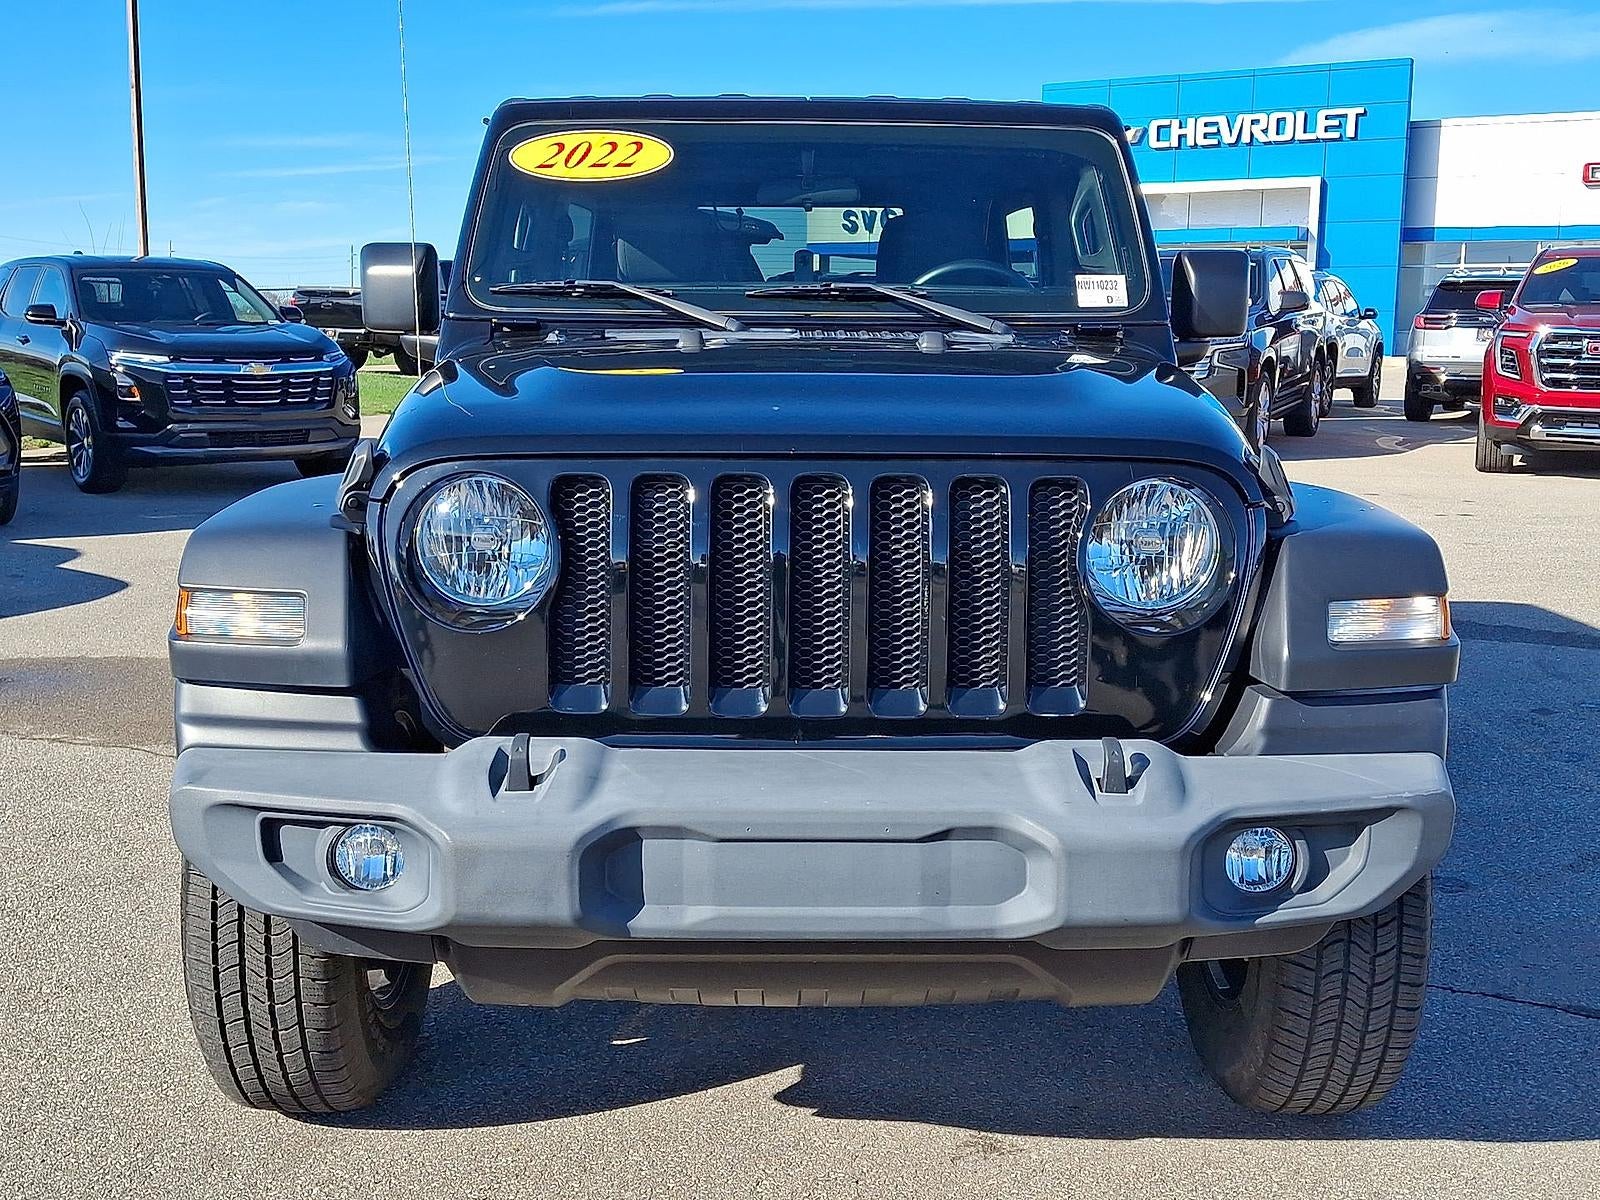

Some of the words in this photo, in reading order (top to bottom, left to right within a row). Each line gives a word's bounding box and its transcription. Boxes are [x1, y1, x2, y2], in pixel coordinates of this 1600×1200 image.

[1148, 106, 1366, 150] CHEVROLET
[534, 140, 644, 169] 2022
[1077, 279, 1118, 291] NW110232
